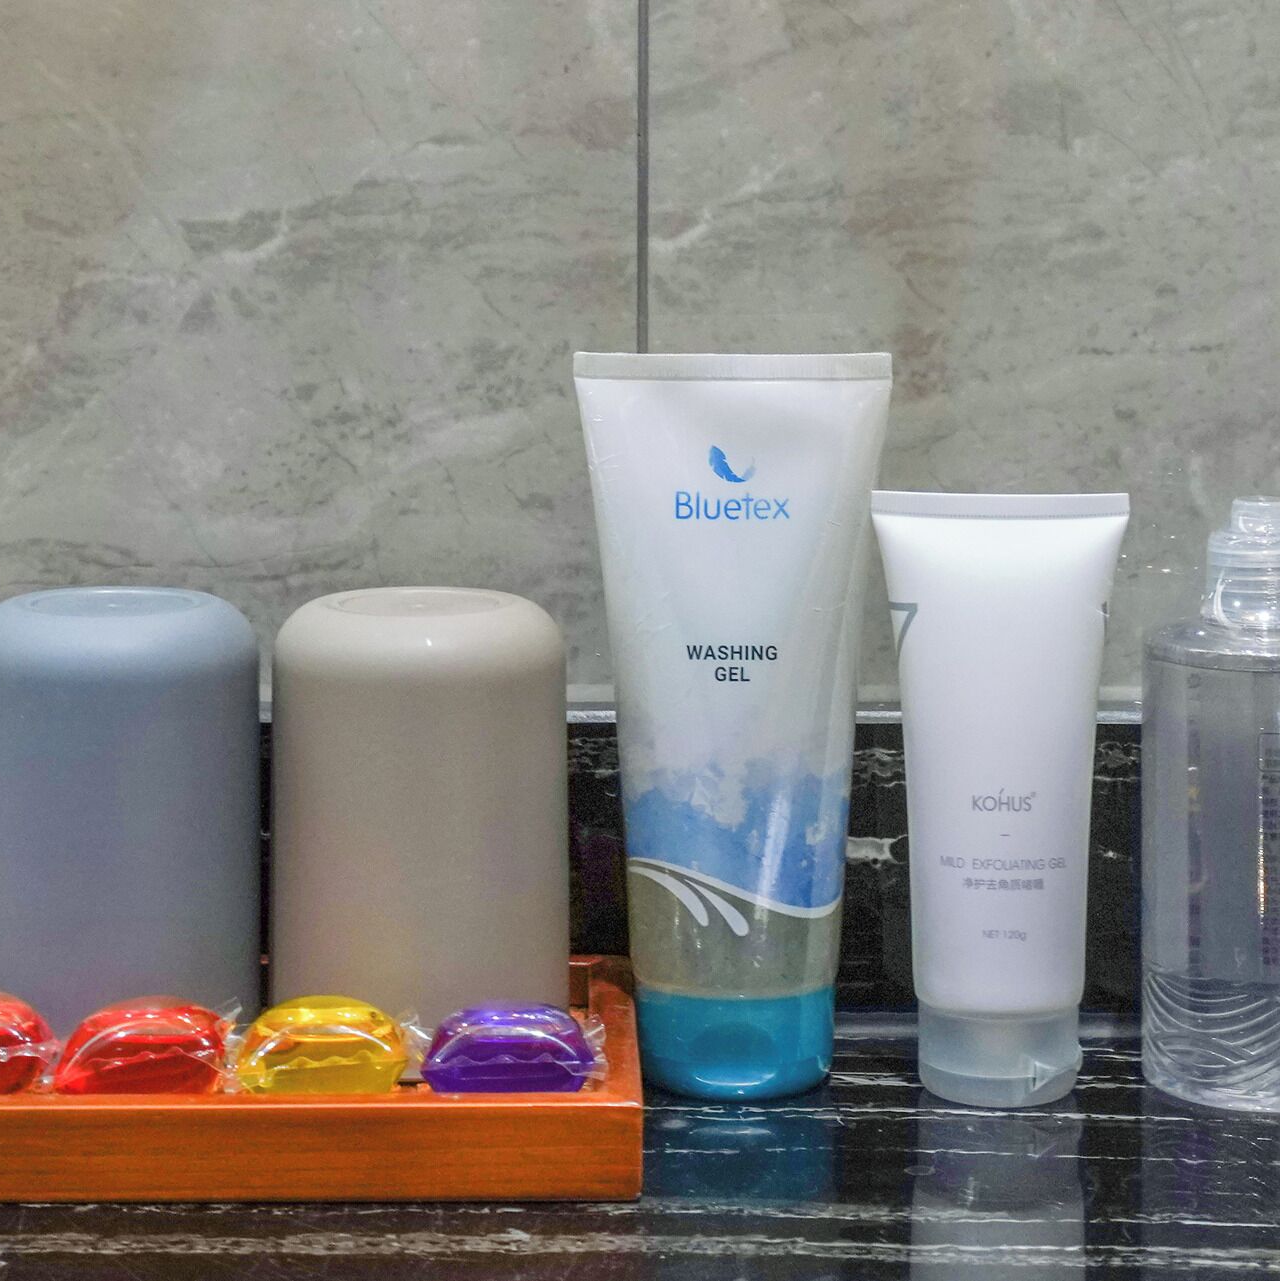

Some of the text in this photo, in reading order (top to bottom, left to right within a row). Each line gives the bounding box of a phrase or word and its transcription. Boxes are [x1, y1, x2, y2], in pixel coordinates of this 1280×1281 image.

[674, 490, 790, 520] Bluetex
[686, 644, 778, 661] WASHING
[714, 666, 751, 682] GEL
[972, 858, 1045, 871] EXFOLIATING
